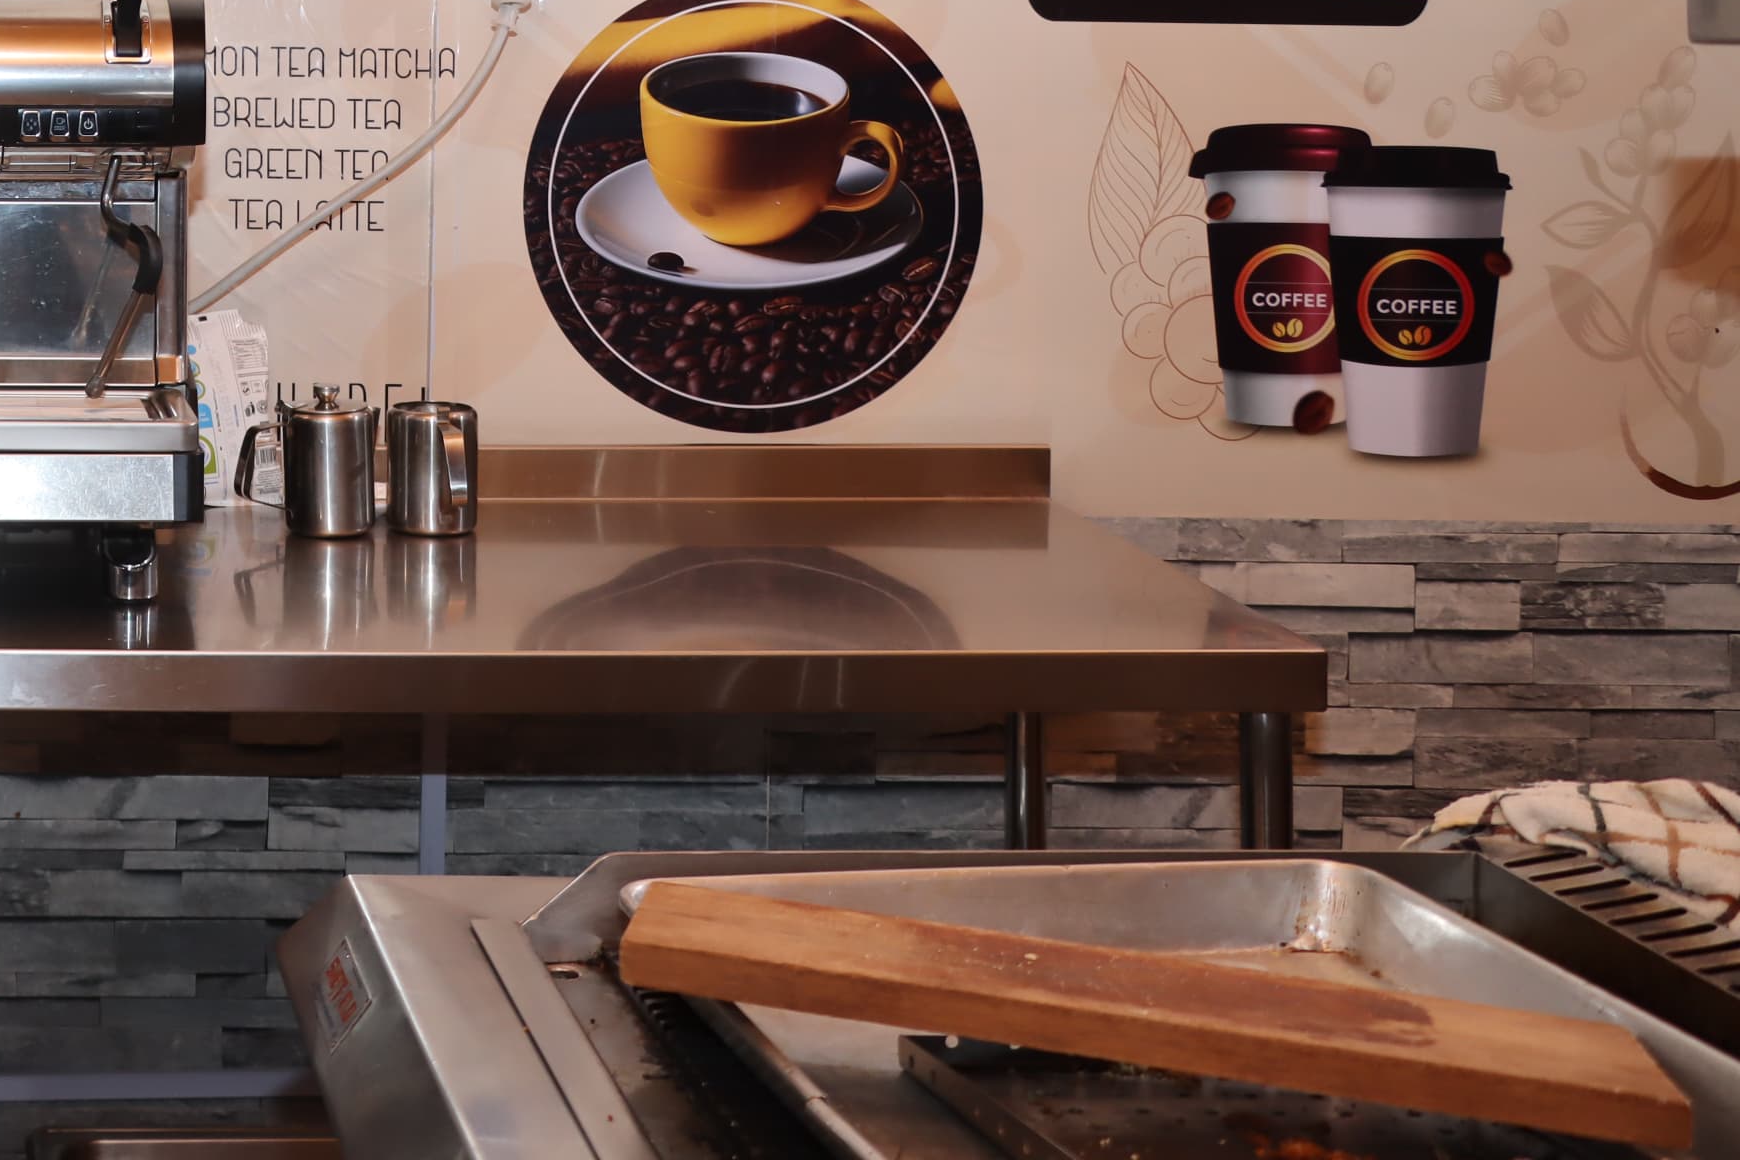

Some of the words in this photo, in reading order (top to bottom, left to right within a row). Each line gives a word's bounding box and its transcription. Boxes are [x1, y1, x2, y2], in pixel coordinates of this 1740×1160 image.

[205, 45, 259, 77] MON
[270, 46, 325, 78] TEA
[339, 47, 456, 80] MATCHA
[213, 96, 336, 129] BREWED
[346, 98, 402, 130] TEA
[225, 148, 323, 180] GREEN
[334, 149, 389, 181] TEA
[228, 199, 283, 230] TEA
[1252, 292, 1327, 308] COFFEE
[1376, 299, 1457, 315] COFFEE
